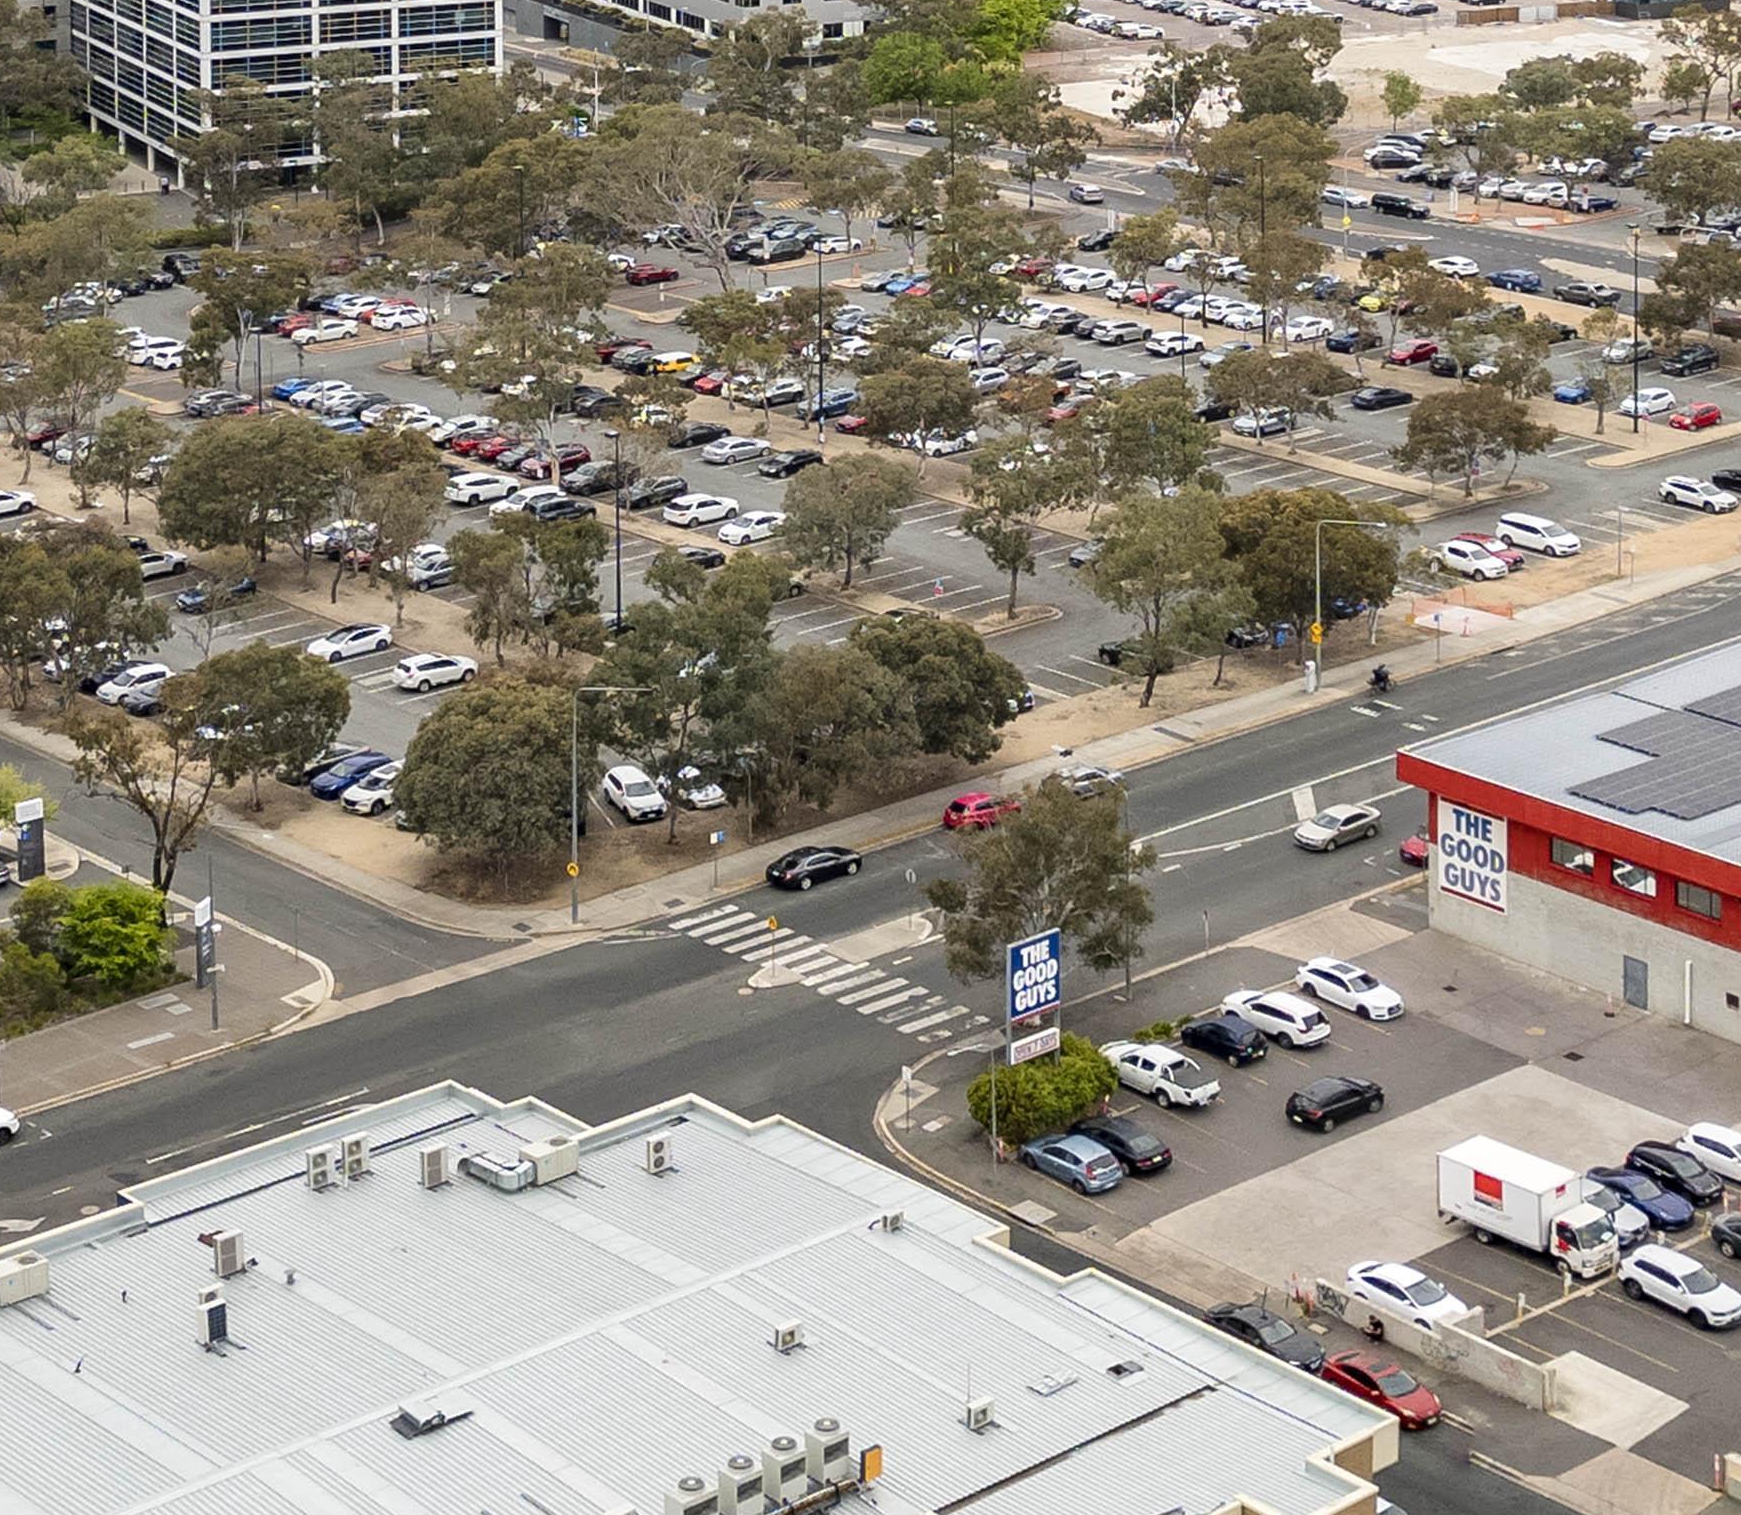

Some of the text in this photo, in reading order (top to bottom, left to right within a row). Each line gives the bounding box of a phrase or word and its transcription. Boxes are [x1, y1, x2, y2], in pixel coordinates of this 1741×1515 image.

[1453, 808, 1493, 843] THE
[1440, 833, 1505, 874] GOOD
[1444, 863, 1501, 902] GUYS
[1020, 939, 1050, 967] THE
[1013, 958, 1058, 991] GOOD
[1015, 980, 1057, 1011] GUYS
